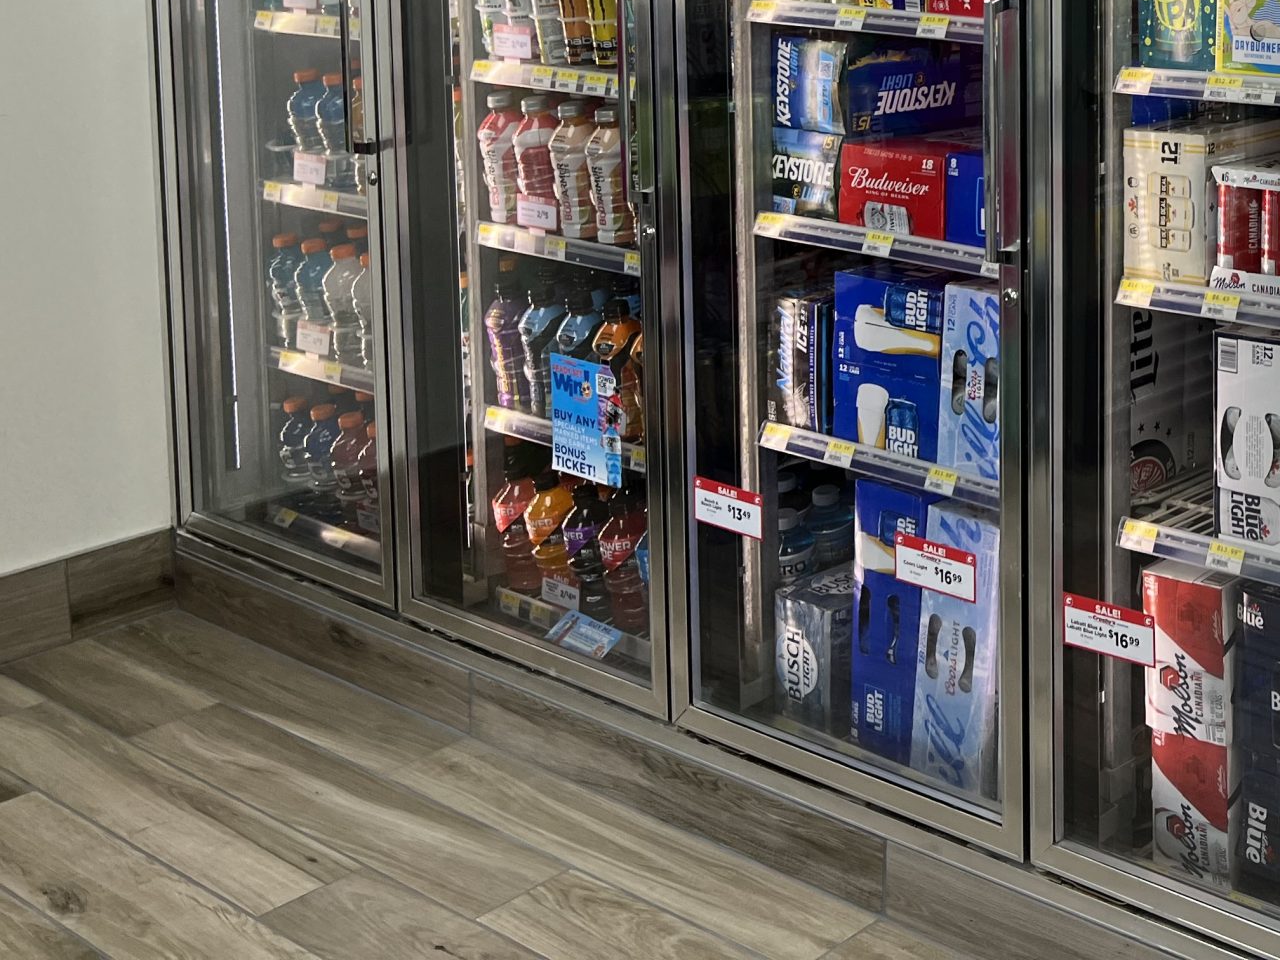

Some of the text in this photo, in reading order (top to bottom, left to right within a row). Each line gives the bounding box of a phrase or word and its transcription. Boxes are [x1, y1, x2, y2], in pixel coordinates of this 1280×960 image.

[791, 44, 799, 75] LIGHT
[776, 39, 792, 126] KEYSTONE
[880, 73, 913, 91] LIGHT
[874, 81, 956, 115] KEYSTONE
[823, 136, 833, 149] 15
[1161, 141, 1179, 165] 12
[772, 155, 834, 186] KEYSTONE
[921, 159, 934, 169] 18
[950, 159, 957, 167] 8
[803, 187, 830, 203] LIGHT
[848, 167, 929, 196] Budweiser
[1213, 277, 1246, 290] Molson
[905, 292, 916, 326] BUD
[916, 290, 929, 331] LIGHT
[776, 307, 795, 391] Natural
[797, 323, 809, 353] ICE
[839, 364, 848, 372] 12
[554, 409, 596, 429] BUY ANY
[888, 426, 915, 443] BUD
[555, 443, 586, 461] BONUS
[555, 456, 597, 477] TICKET!
[718, 487, 737, 498] SALE!
[1231, 492, 1244, 538] LIGHT
[1244, 494, 1260, 540] Blue
[923, 544, 945, 557] SALE!
[1095, 605, 1121, 619] SALE!
[1237, 602, 1264, 629] Blue
[788, 628, 803, 703] BUSCH
[802, 647, 811, 689] LIGHT
[865, 692, 876, 722] BUD
[874, 690, 885, 732] LIGHT
[1247, 802, 1268, 864] Blue
